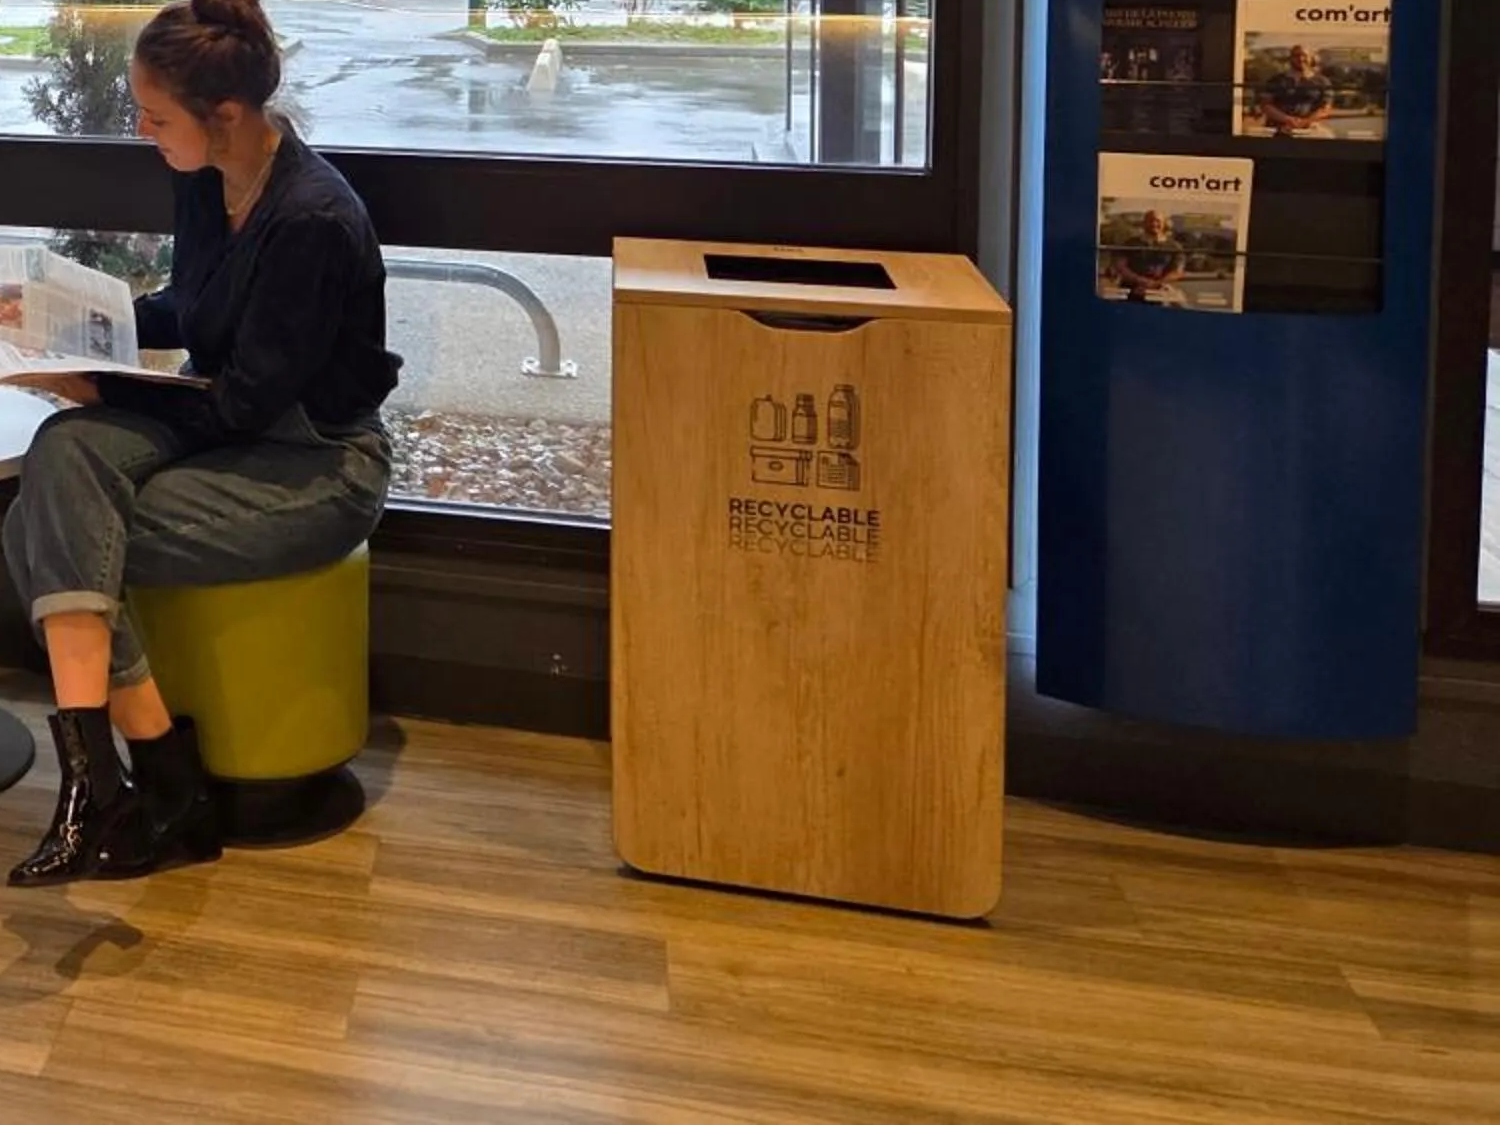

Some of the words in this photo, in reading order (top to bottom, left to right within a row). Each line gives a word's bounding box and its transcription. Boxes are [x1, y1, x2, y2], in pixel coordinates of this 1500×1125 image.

[1295, 3, 1392, 23] com'art
[1149, 173, 1242, 192] com'art
[728, 497, 880, 527] RECYCLABLE
